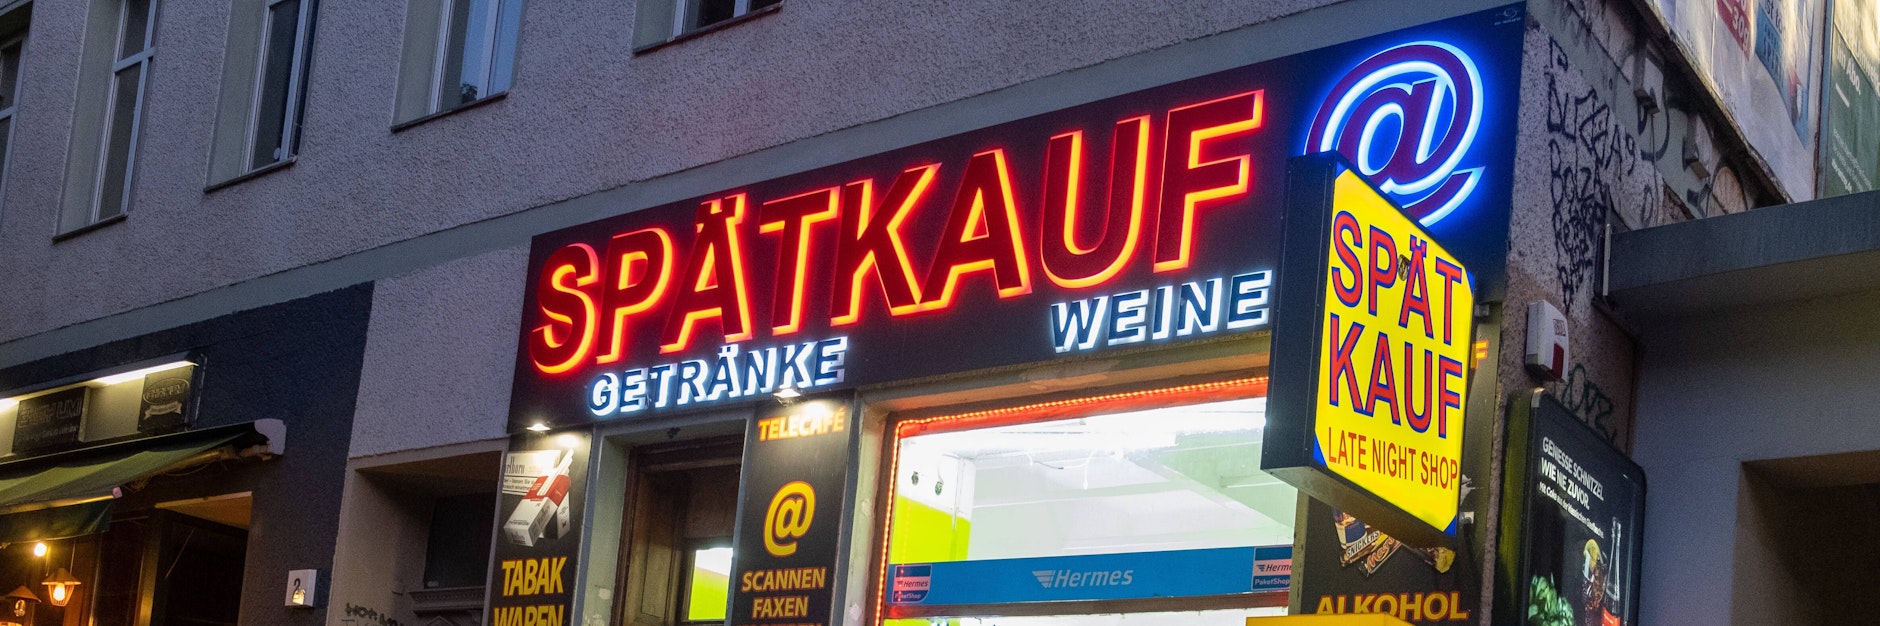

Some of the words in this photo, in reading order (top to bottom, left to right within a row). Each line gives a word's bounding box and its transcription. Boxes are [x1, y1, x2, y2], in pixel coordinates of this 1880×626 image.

[1304, 40, 1486, 228] @
[529, 88, 1265, 374] SPÄTKAUF
[1331, 210, 1463, 346] SPÄT
[1050, 269, 1273, 353] WEINE
[589, 335, 848, 416] GETRÄNKE
[1328, 312, 1463, 439] KAUF
[757, 404, 847, 442] TELECAFÉ
[1328, 427, 1367, 471] LATE
[1372, 438, 1416, 482] NIGHT
[1420, 451, 1459, 490] SHOP
[1541, 457, 1557, 482] WIE
[1557, 469, 1567, 491] NIE
[1542, 436, 1573, 474] GENIESSE
[1573, 462, 1604, 501] SCHNITZEL
[763, 480, 817, 557] @
[1346, 530, 1380, 559] SNICKERS
[501, 555, 568, 597] TABAK
[741, 566, 827, 592] SCANNEN
[903, 580, 929, 588] Hermes
[1054, 569, 1134, 588] Hermes
[752, 595, 810, 619] FAXEN
[1315, 591, 1470, 622] ALKOHOL
